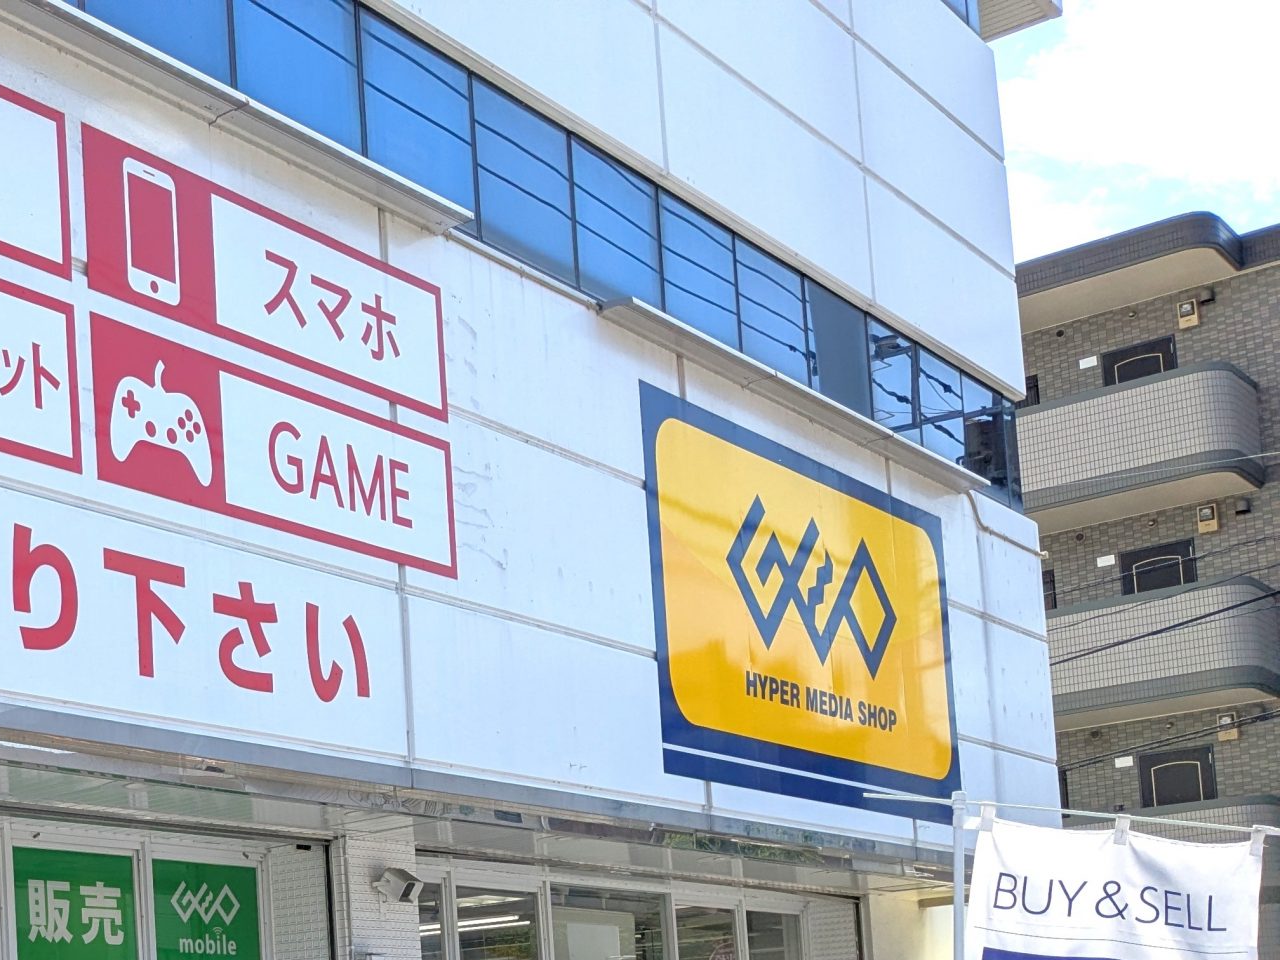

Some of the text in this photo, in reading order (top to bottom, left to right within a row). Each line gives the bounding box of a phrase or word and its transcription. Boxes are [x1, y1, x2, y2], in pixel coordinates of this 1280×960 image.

[264, 249, 401, 361] スマホ
[267, 421, 413, 529] GAME
[745, 671, 897, 732] HYPER MEDIA SHOP
[179, 933, 237, 955] mobile
